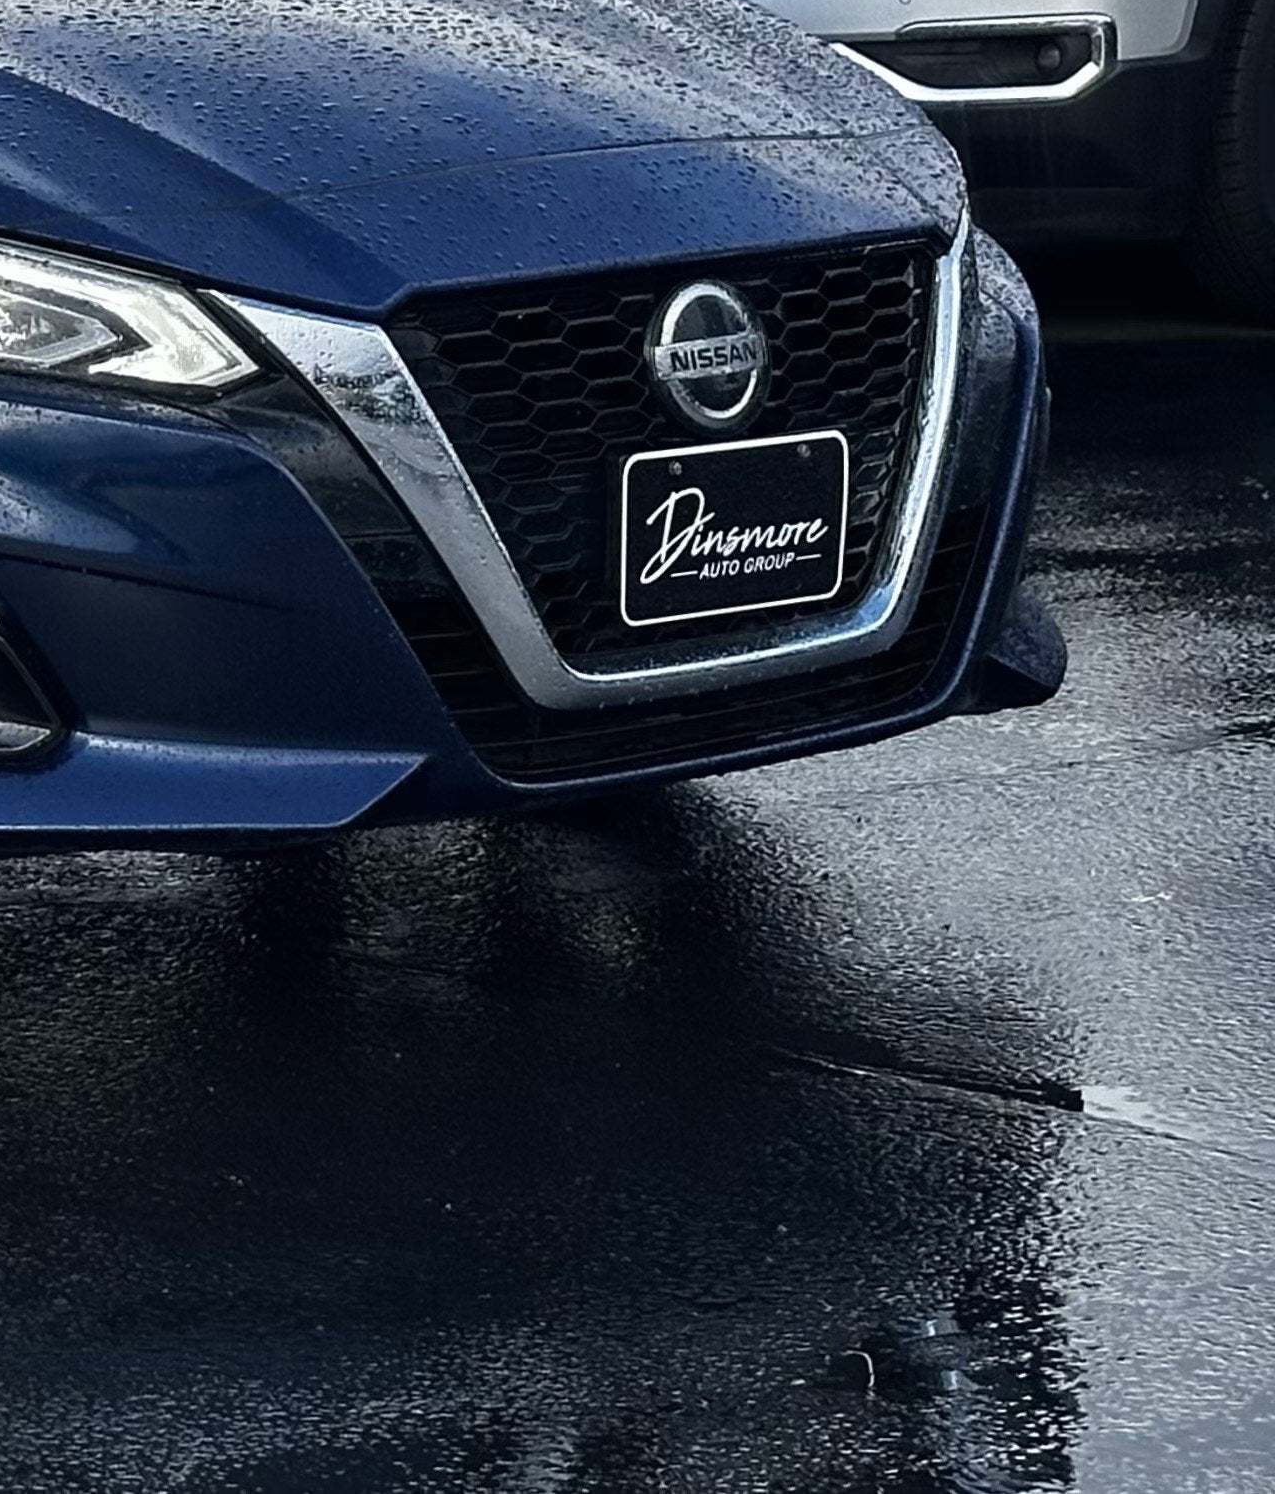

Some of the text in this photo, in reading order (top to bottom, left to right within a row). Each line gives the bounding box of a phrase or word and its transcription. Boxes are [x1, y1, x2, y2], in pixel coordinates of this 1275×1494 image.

[670, 341, 758, 373] NISSAN
[640, 487, 829, 584] Dinsmore
[699, 552, 795, 580] AUTO GROUP
